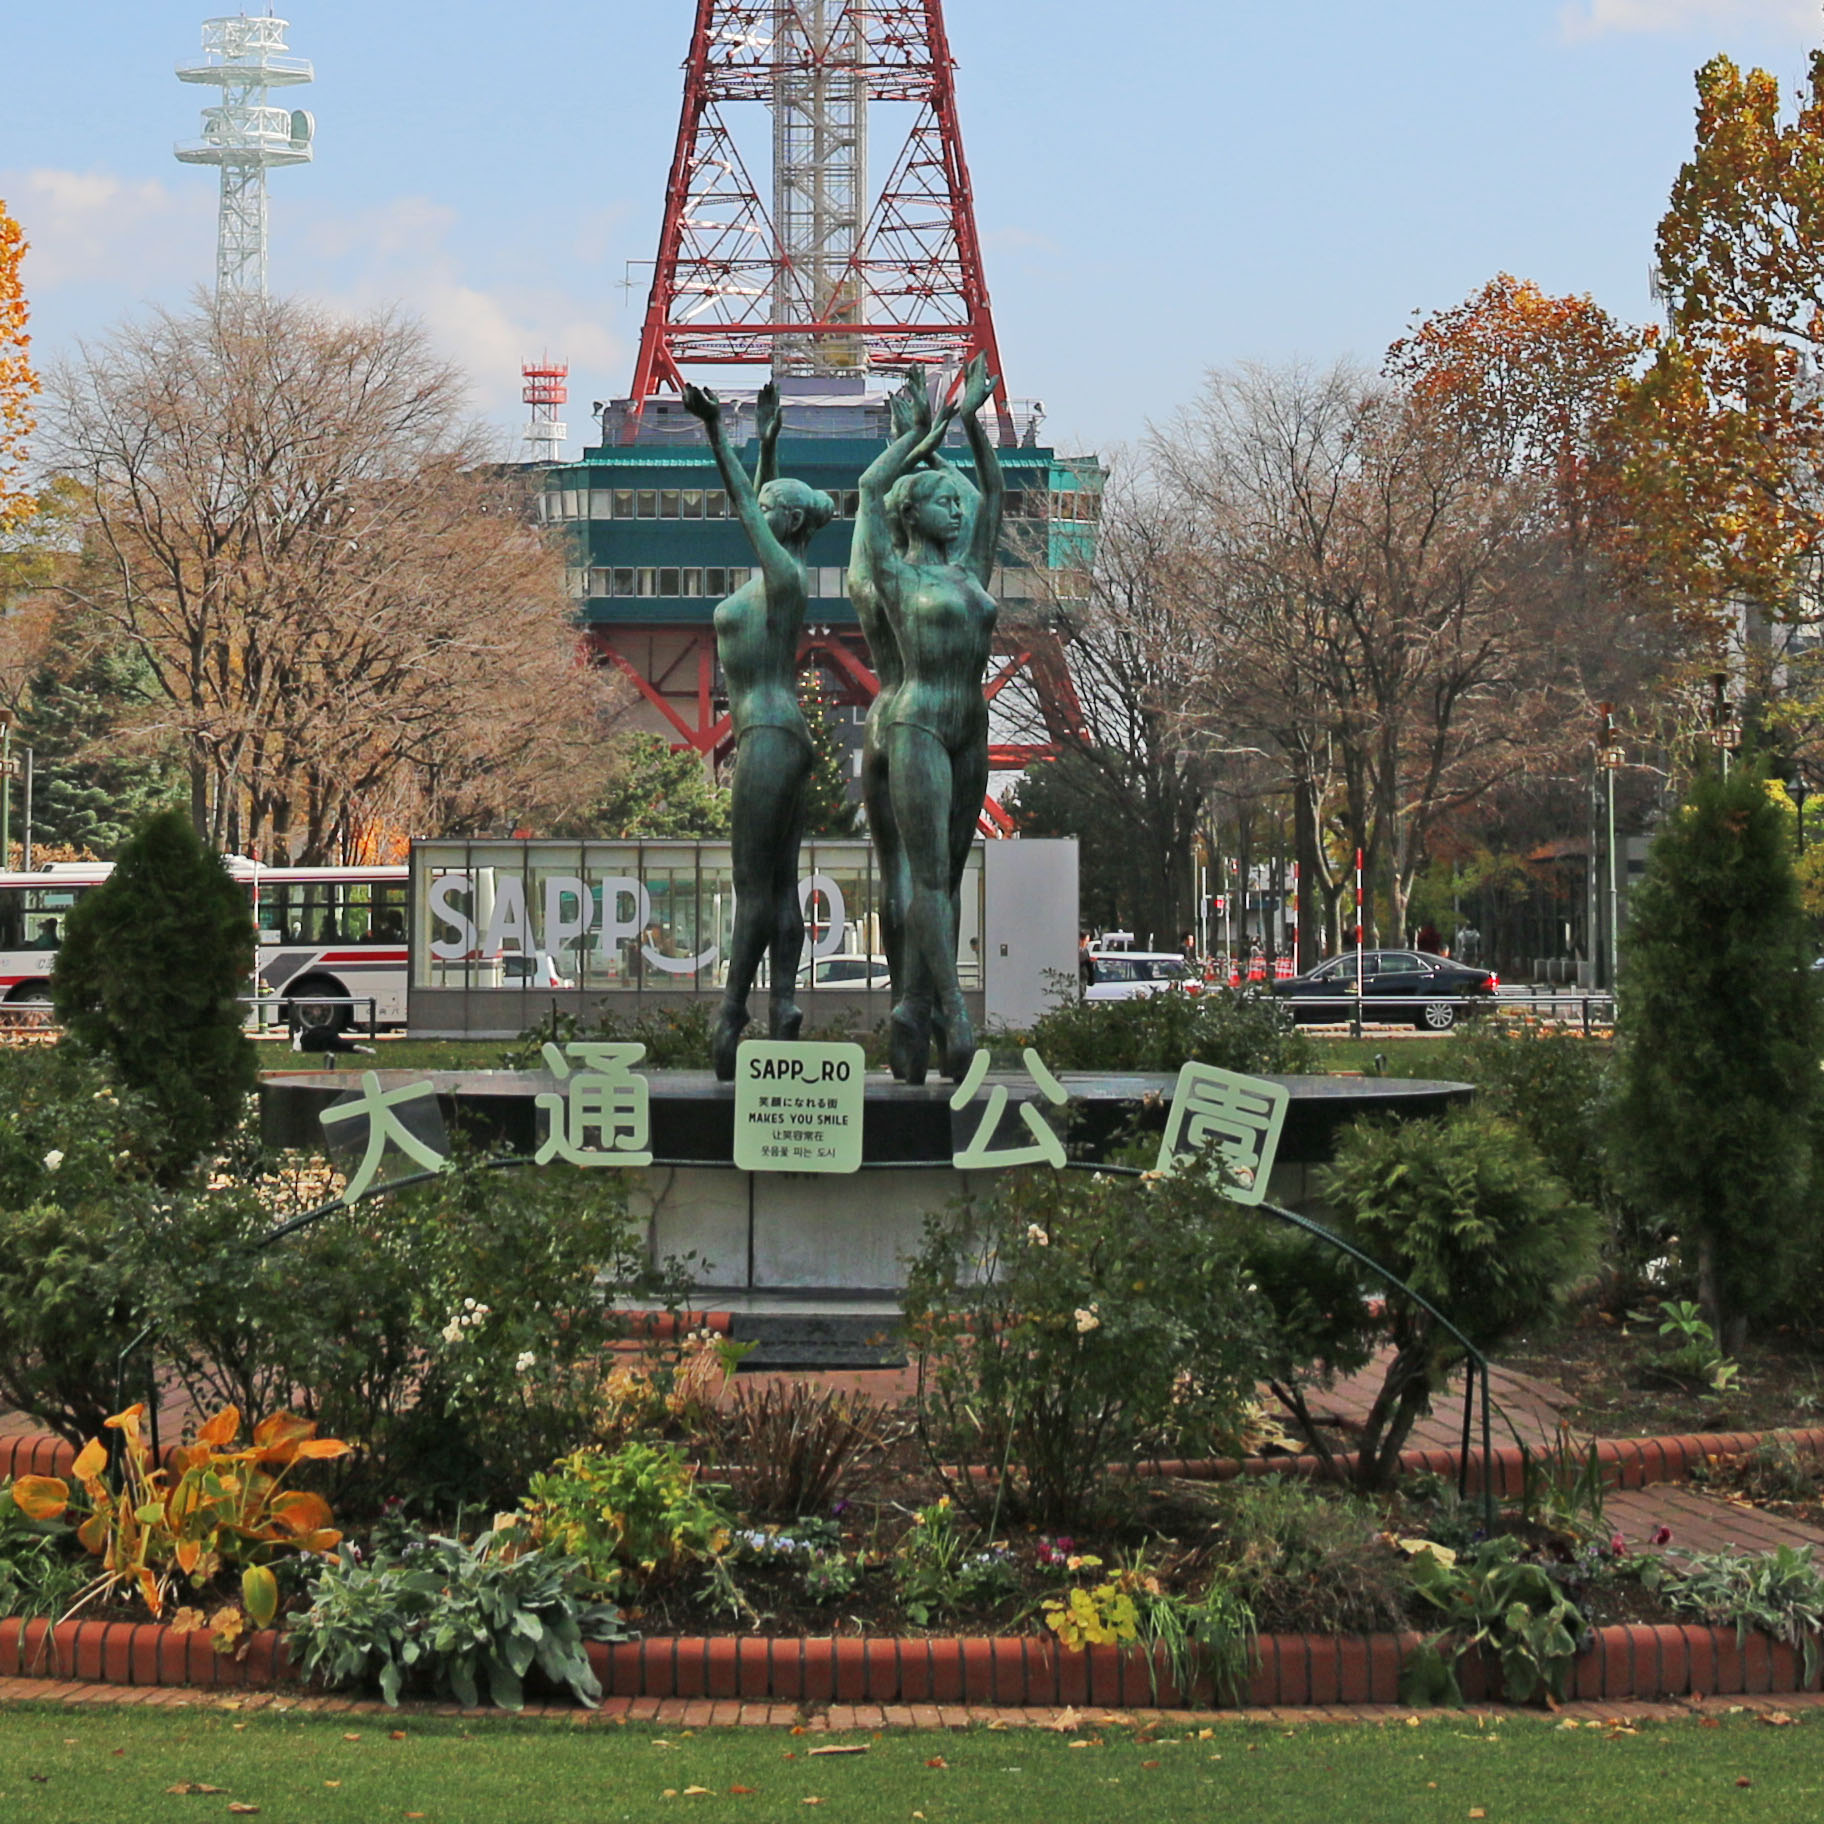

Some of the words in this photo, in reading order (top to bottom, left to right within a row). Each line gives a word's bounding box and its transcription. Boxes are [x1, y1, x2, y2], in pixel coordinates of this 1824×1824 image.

[759, 1097, 838, 1109] 笑顔になれる街
[748, 1113, 785, 1124] MAKES
[790, 1114, 813, 1125] YOU
[817, 1115, 849, 1126] SMILE
